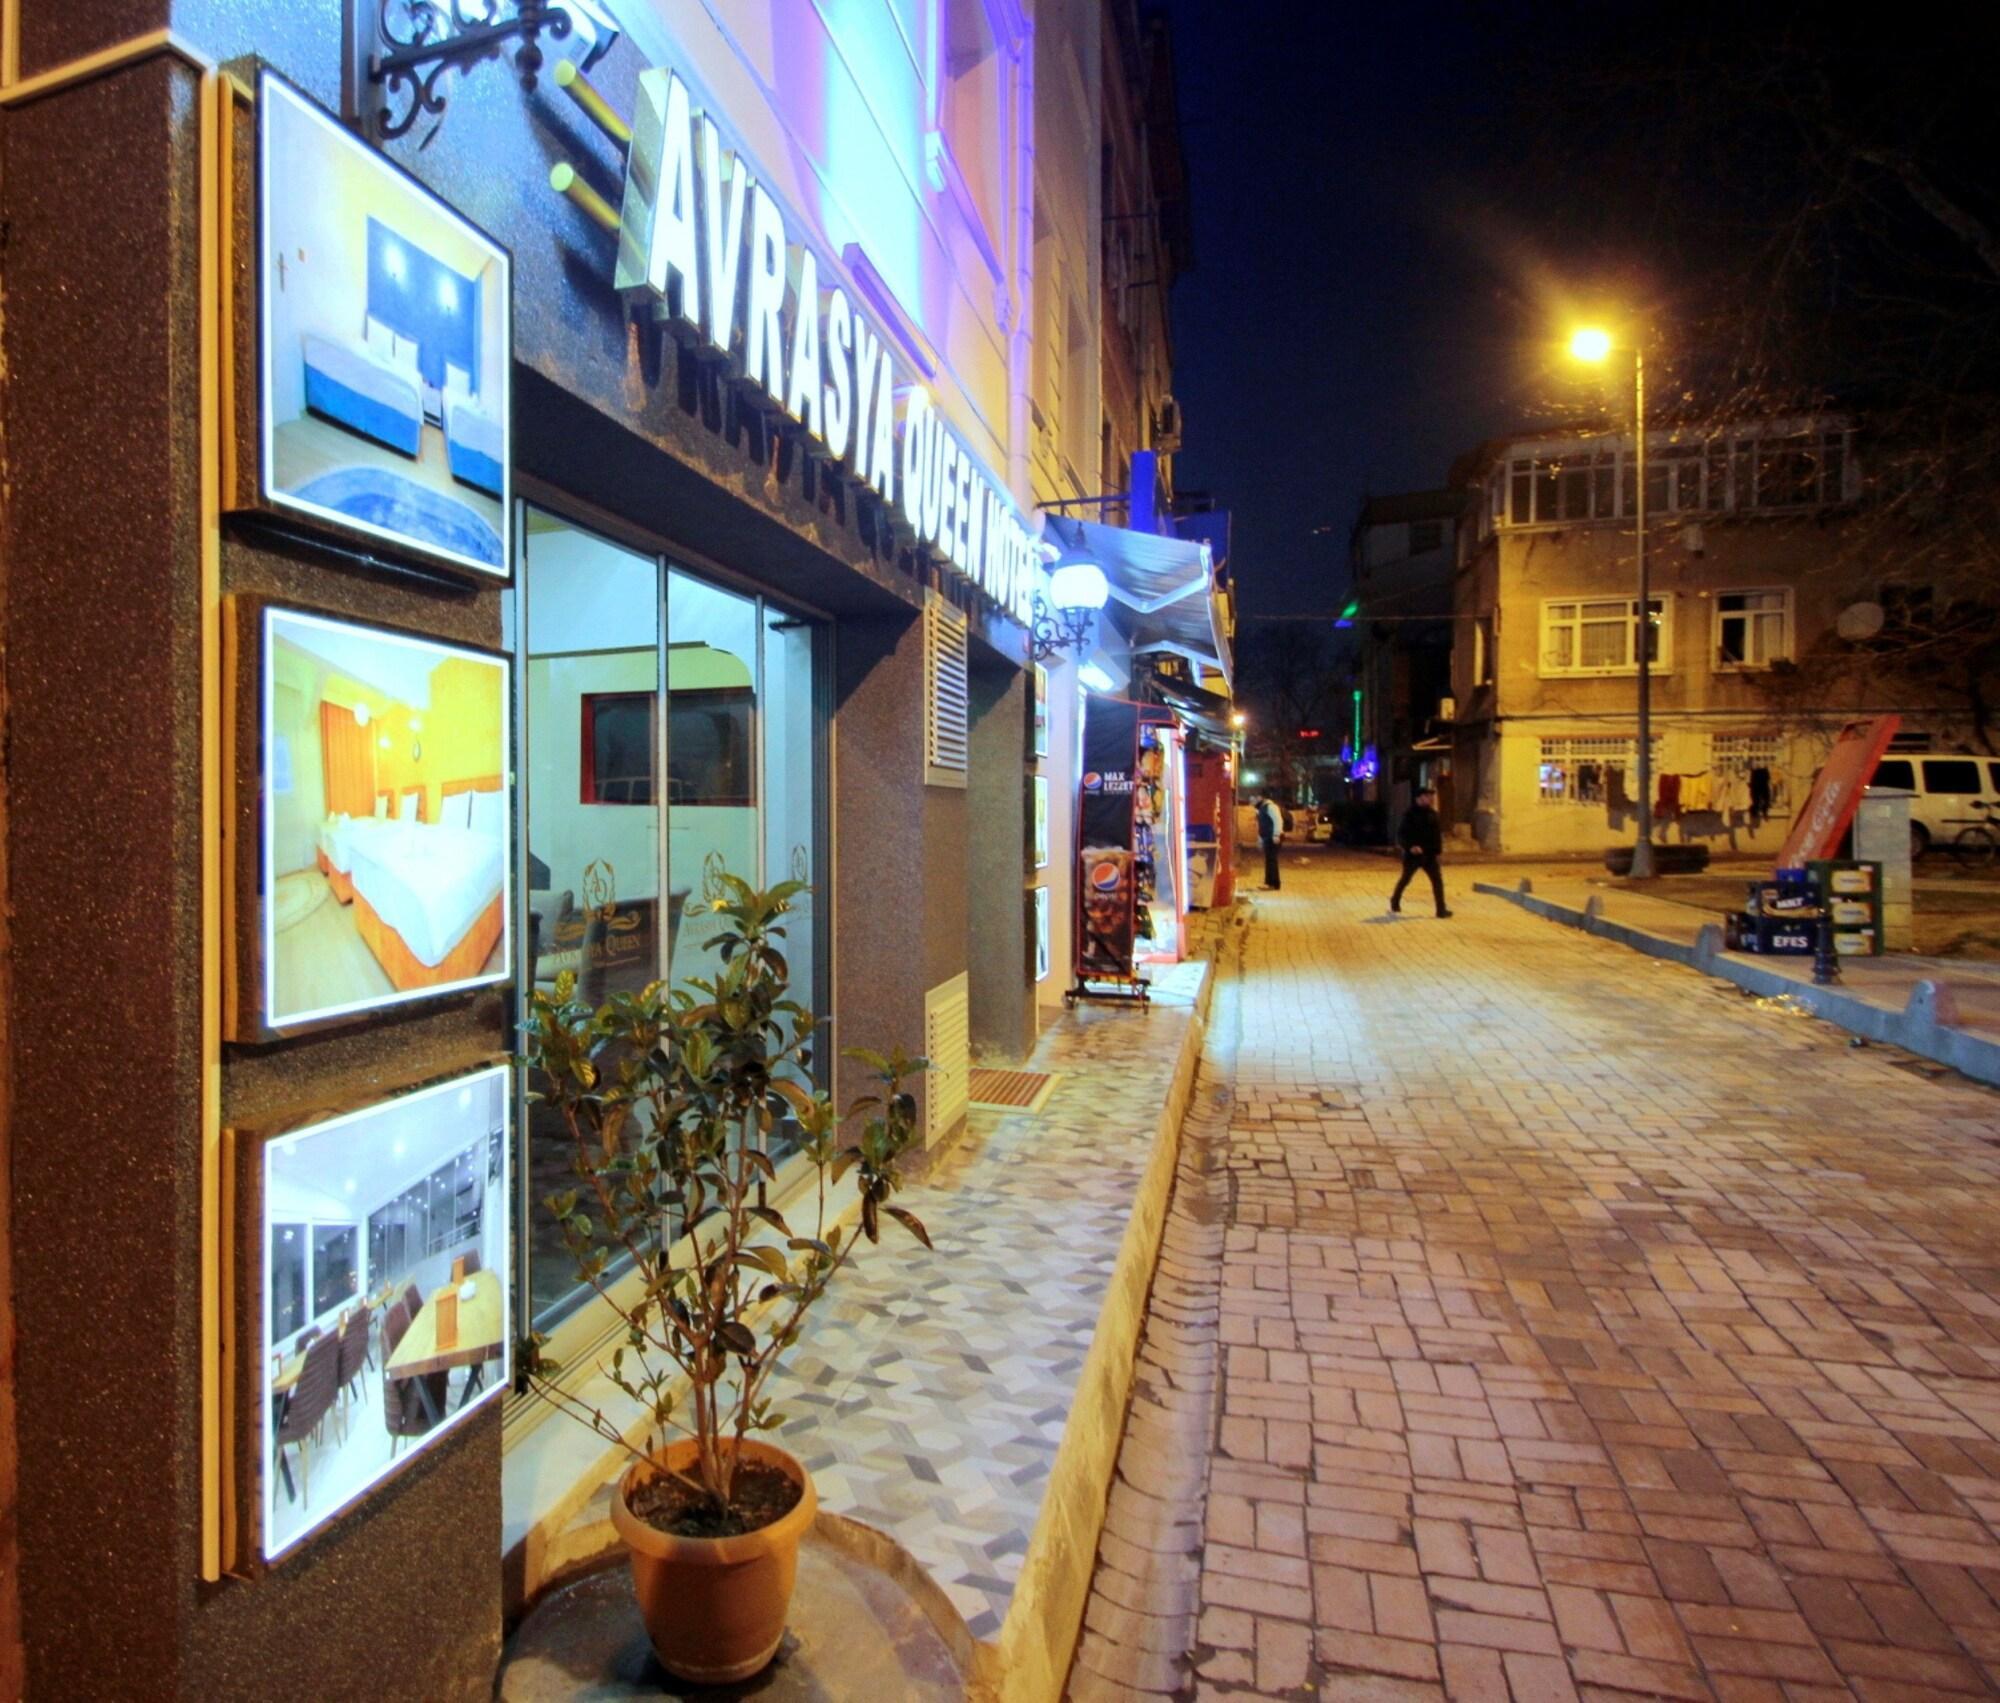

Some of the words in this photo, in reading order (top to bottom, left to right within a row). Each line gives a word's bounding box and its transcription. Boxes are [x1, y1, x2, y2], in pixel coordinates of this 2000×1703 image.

[648, 70, 896, 504] AVRASYA
[903, 387, 984, 583] QUEEN
[1104, 771, 1125, 781] MAX
[1772, 935, 1809, 949] EFES
